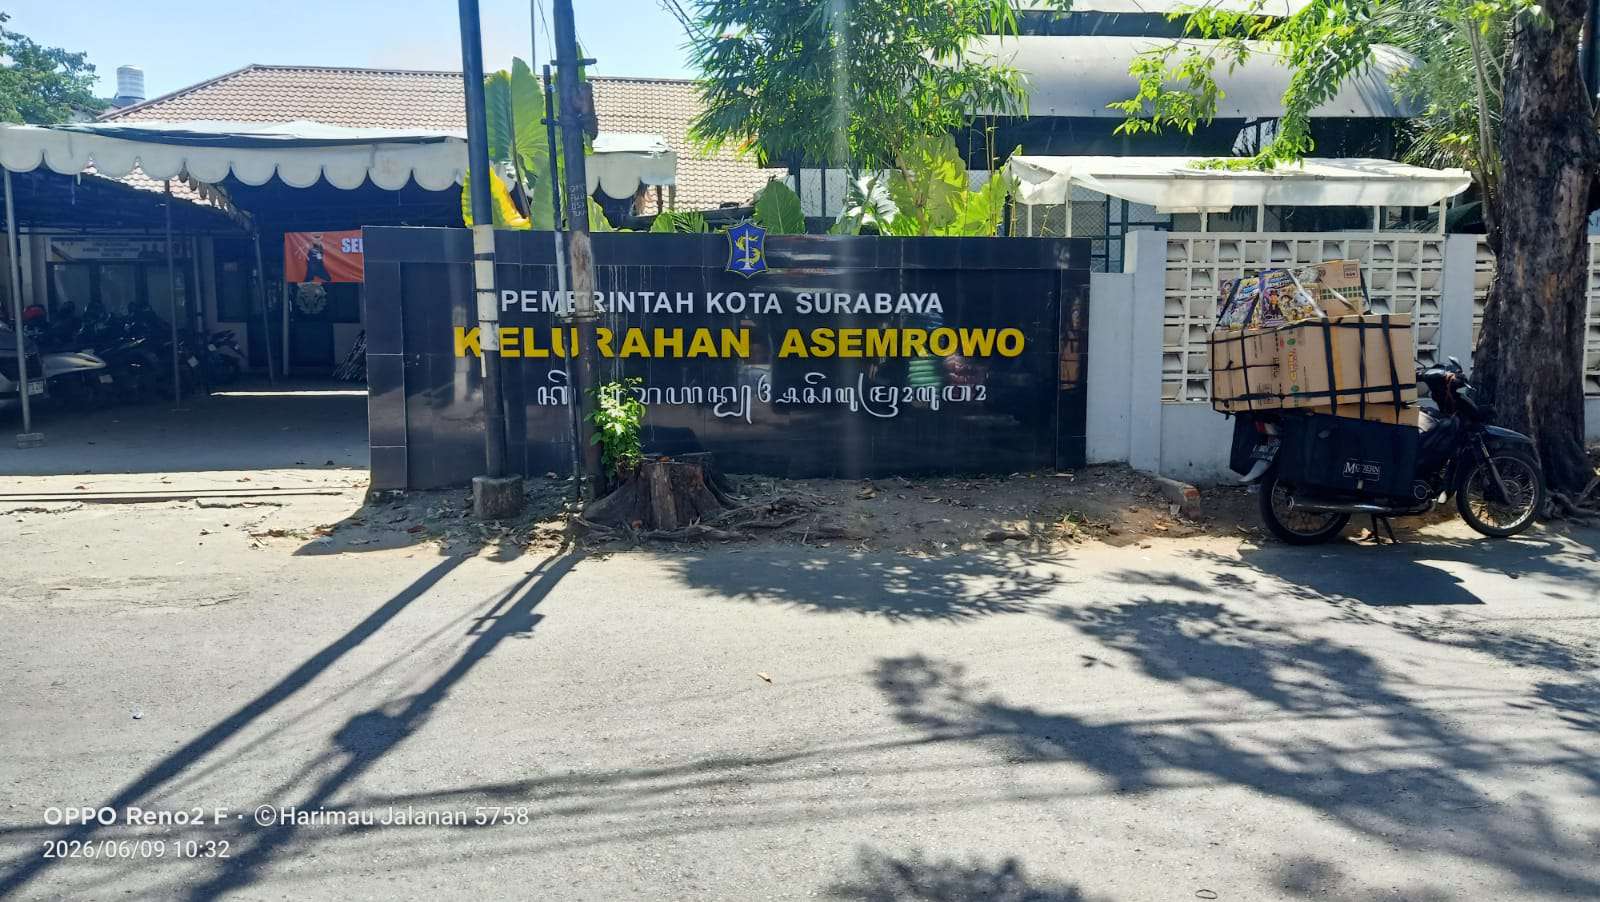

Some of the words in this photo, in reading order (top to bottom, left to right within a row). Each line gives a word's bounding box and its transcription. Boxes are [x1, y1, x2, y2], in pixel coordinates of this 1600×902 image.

[501, 290, 694, 314] PEMERINTAH
[706, 292, 783, 314] KOTA
[796, 292, 944, 314] SURABAYA
[454, 326, 750, 358] KELURAHAN
[778, 327, 1026, 358] ASEMROWO
